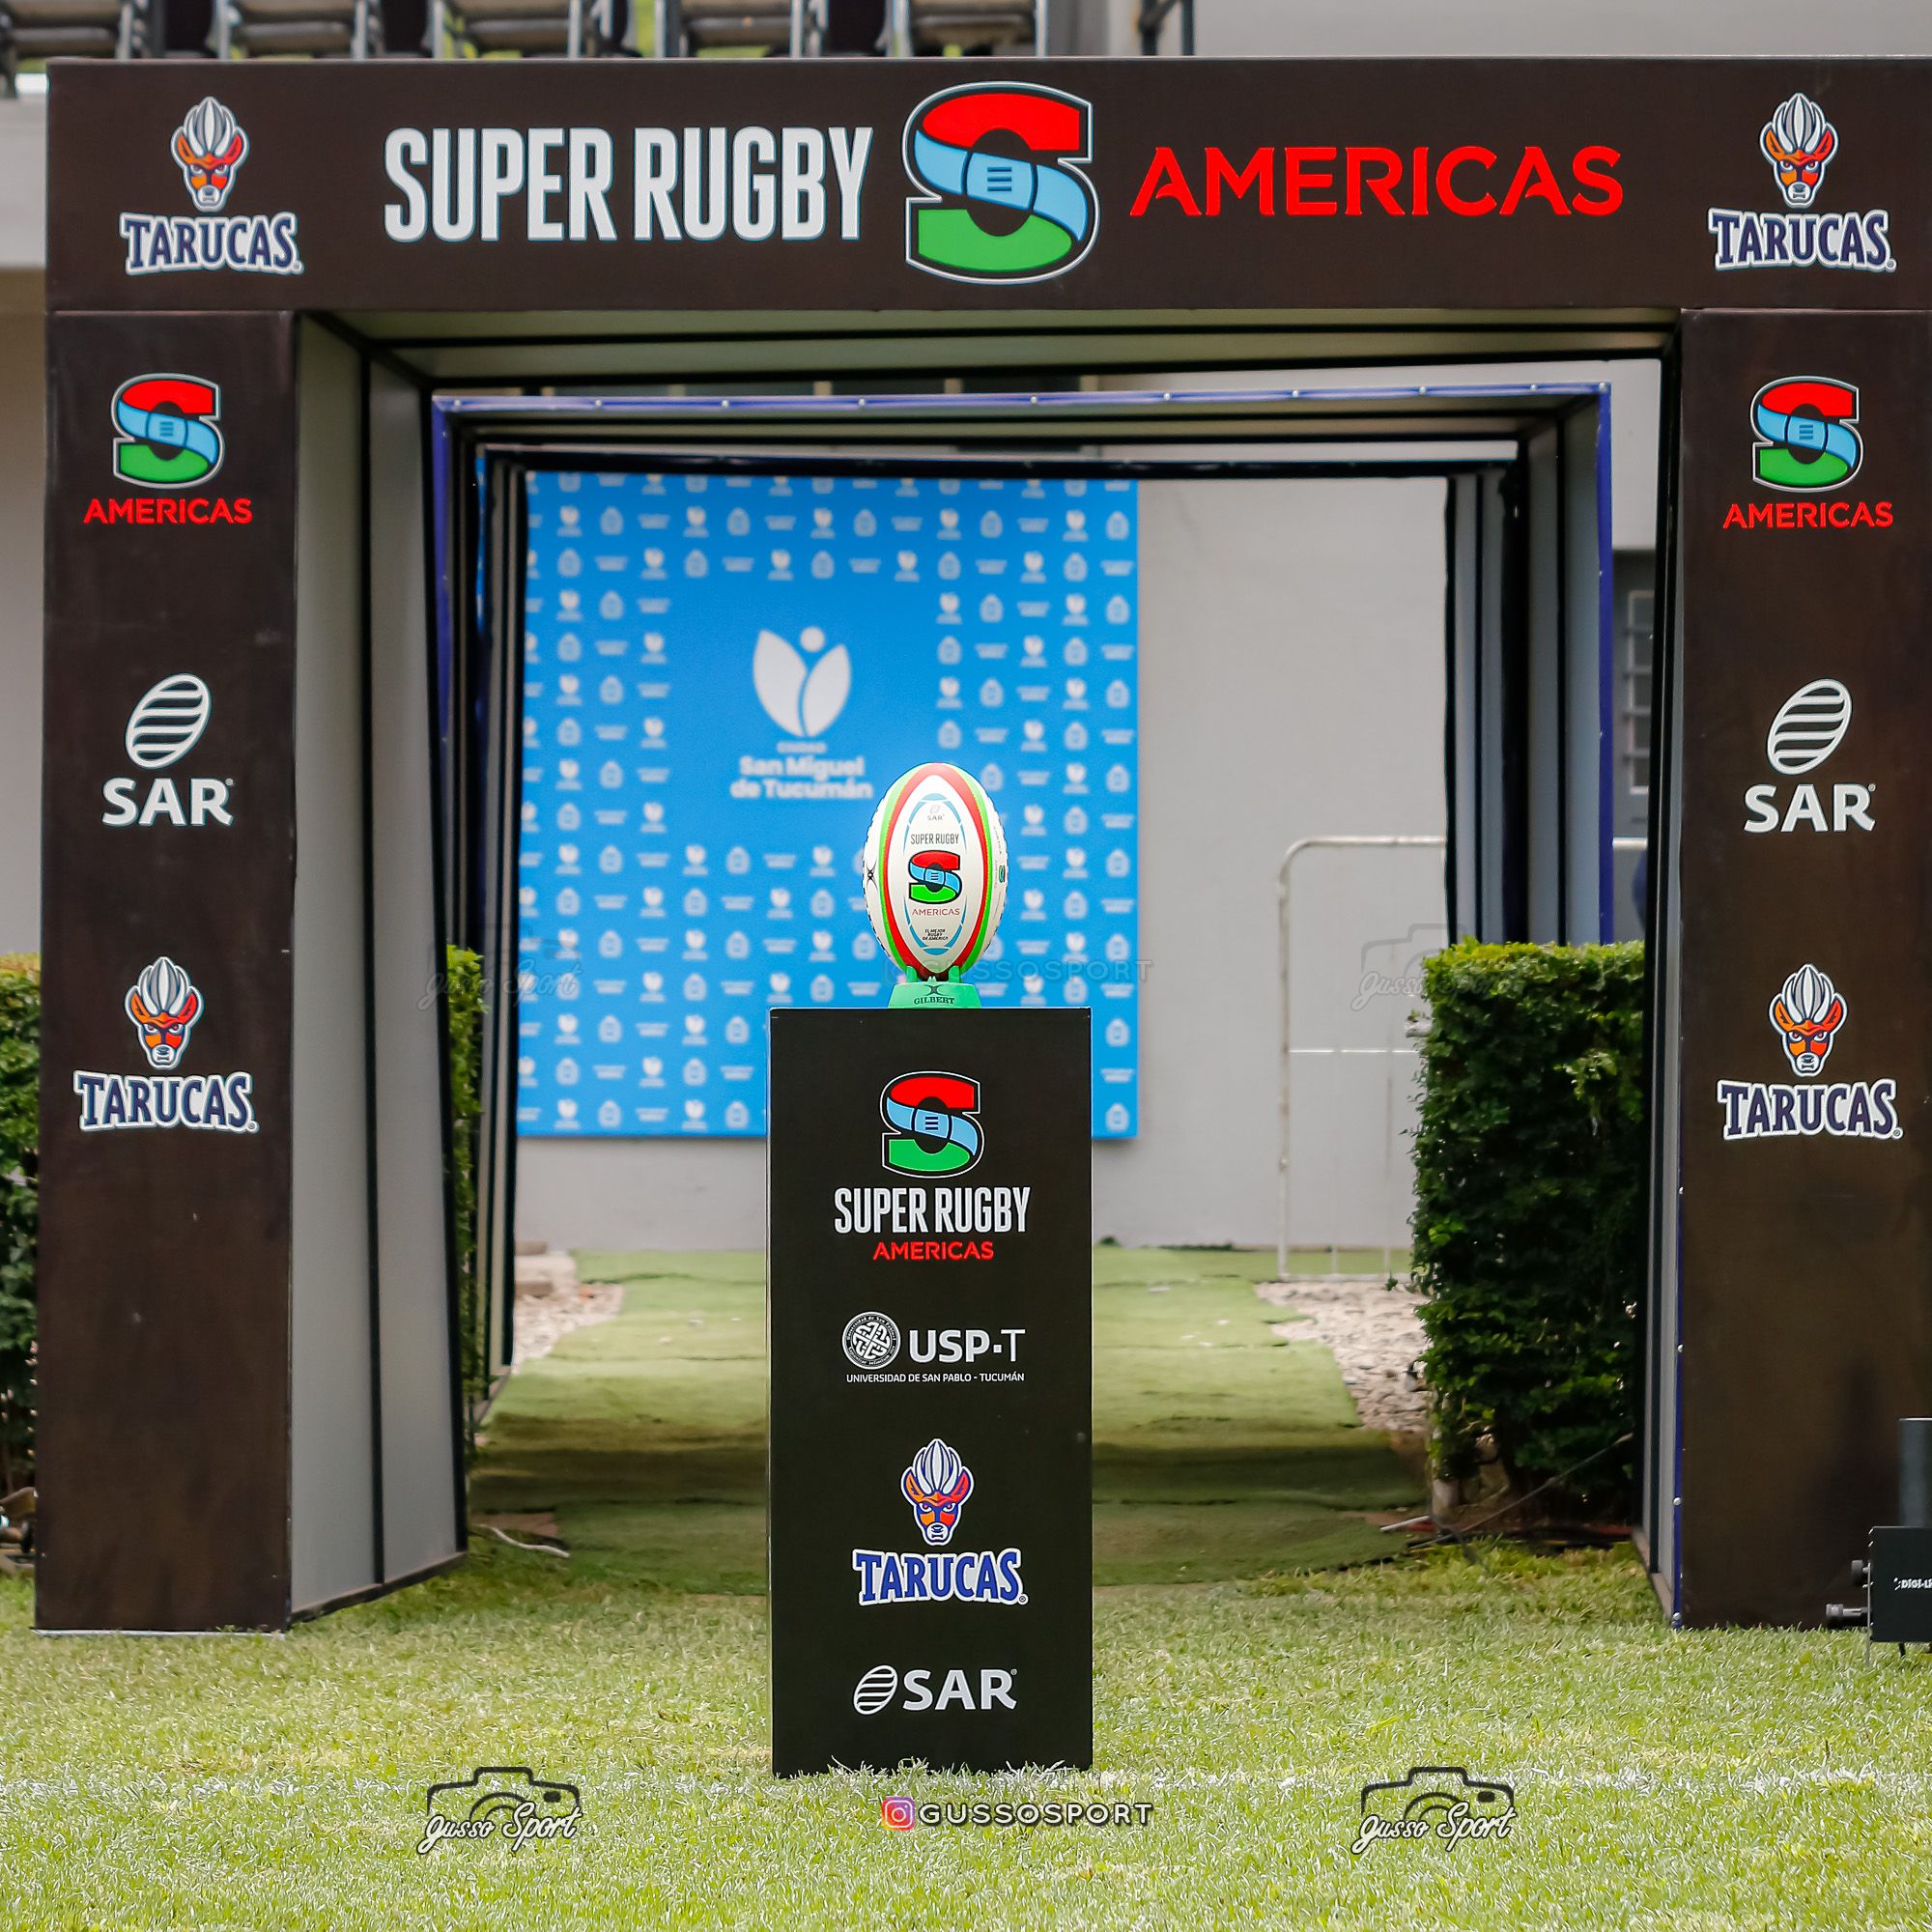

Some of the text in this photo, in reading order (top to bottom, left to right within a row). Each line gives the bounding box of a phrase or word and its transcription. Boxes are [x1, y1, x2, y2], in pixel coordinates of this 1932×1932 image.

[385, 128, 617, 242] SUPER
[635, 127, 873, 240] RUGBY
[1130, 145, 1624, 217] AMERICAS
[83, 497, 253, 525] AMERICAS
[1723, 501, 1893, 529] AMERICAS
[739, 755, 865, 781] San Miguel
[729, 778, 761, 798] de
[910, 833, 959, 844] SUPER RUGBY
[914, 996, 954, 1005] GILBERT
[835, 1187, 1030, 1233] SUPER RUGBY
[873, 1241, 994, 1261] AMERICAS
[846, 1373, 906, 1382] UNIVERSIDAD
[908, 1373, 920, 1382] DE
[922, 1373, 941, 1382] SAN
[943, 1373, 971, 1382] PABLO
[980, 1371, 1025, 1382] TUCUMÁN
